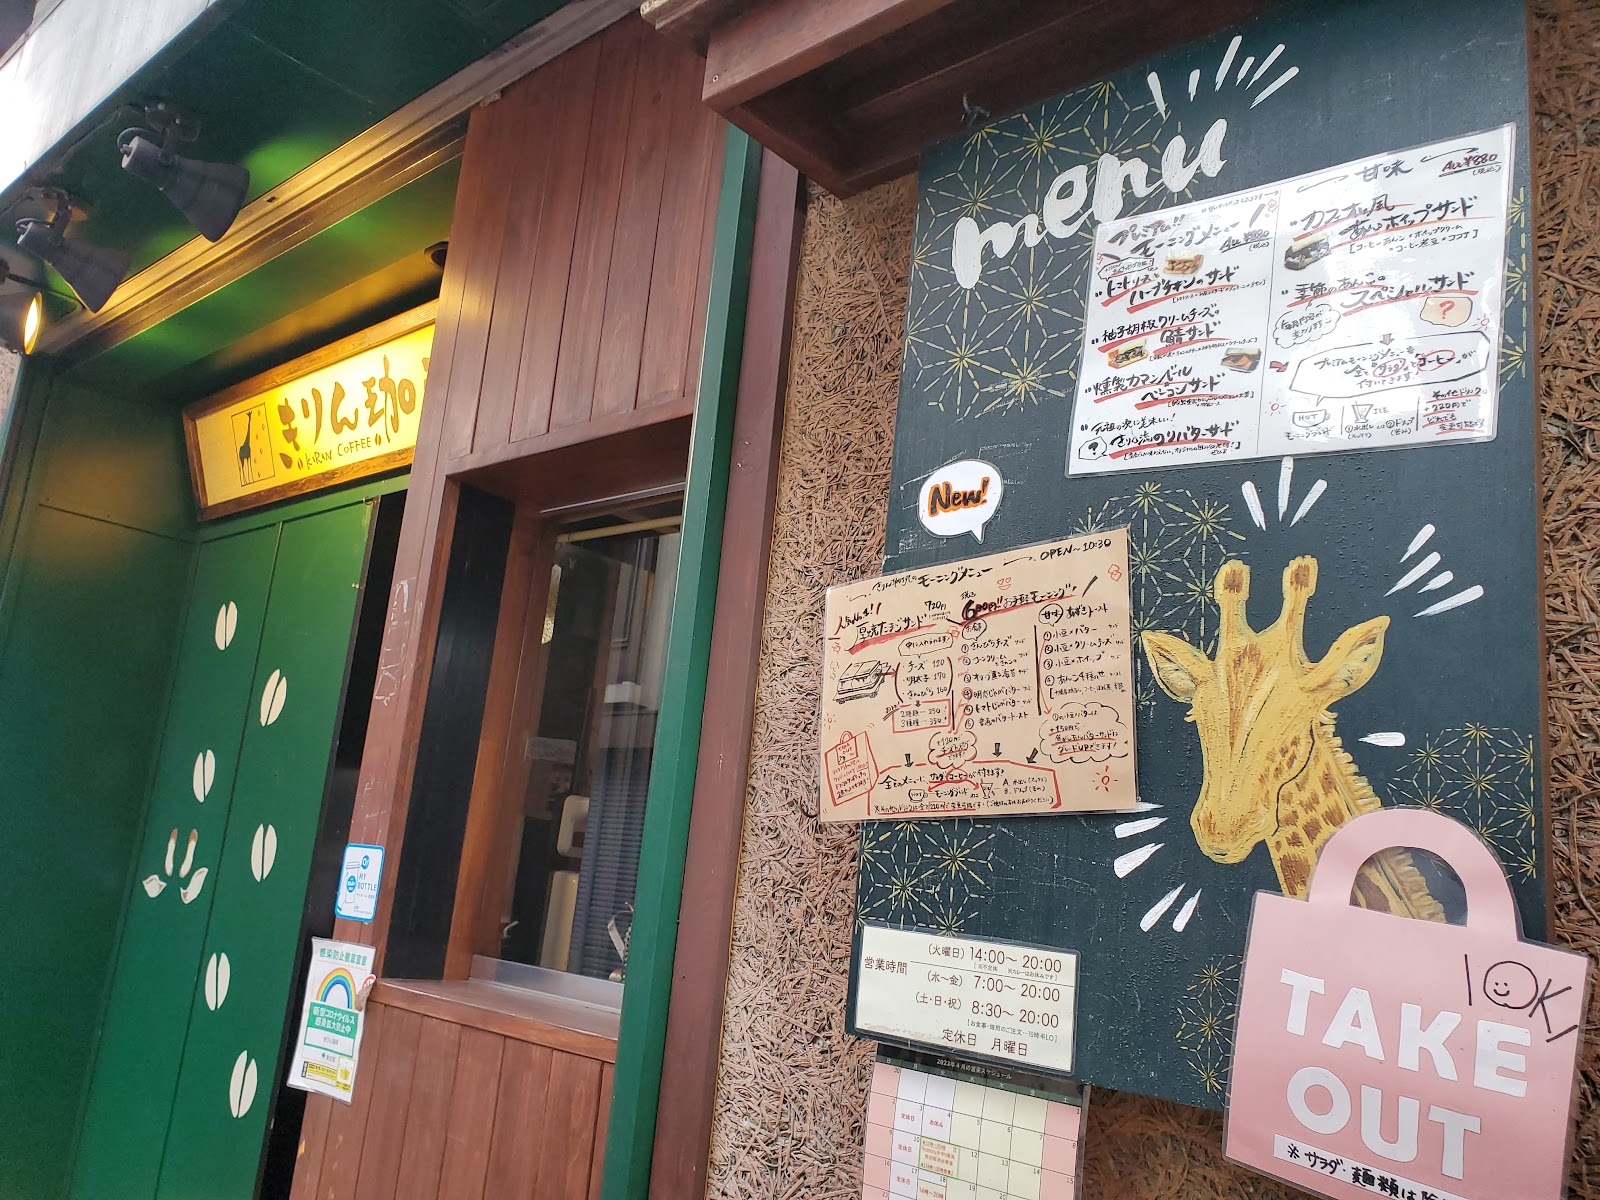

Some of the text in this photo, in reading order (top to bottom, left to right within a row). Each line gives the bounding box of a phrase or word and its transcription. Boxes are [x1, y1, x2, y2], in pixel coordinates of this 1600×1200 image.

[1355, 159, 1413, 183] 甘味
[952, 118, 1227, 289] menu
[1341, 271, 1475, 309] スペシャルサンド
[1439, 300, 1456, 320] ?
[277, 354, 429, 470] きりん珈
[1373, 406, 1389, 414] ICE
[928, 476, 991, 518] New!
[925, 600, 947, 612] 720円
[1040, 609, 1062, 620] 甘味
[932, 658, 945, 668] 120
[357, 882, 377, 892] BOTTLE
[863, 956, 908, 976] 営業時間
[928, 942, 965, 960] (火曜日)
[1022, 954, 1062, 973] 20:00
[1020, 983, 1061, 1003] 20:00
[313, 1006, 355, 1025] 新型コロナウイルス
[314, 1016, 352, 1034] 感染拡大防止中
[1019, 1008, 1059, 1029] 20:00
[942, 1028, 1029, 1057] 定休日 月曜日
[1279, 968, 1532, 1098] TAKE
[1286, 1065, 1482, 1180] OUT
